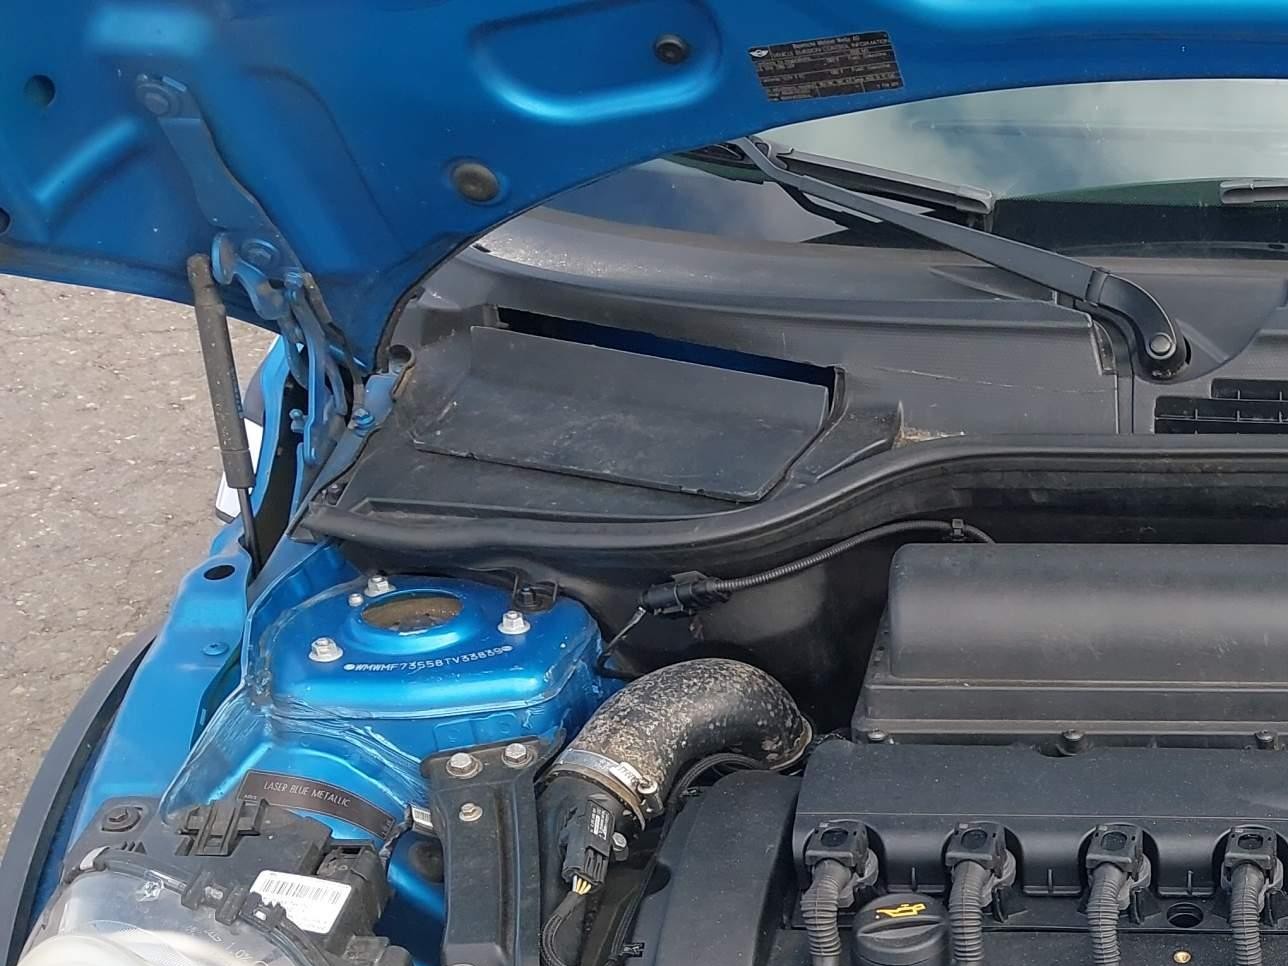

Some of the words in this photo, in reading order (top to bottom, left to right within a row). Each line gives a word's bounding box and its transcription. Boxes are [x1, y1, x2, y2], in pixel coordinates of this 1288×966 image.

[263, 781, 288, 793] LASER
[289, 784, 310, 796] BLUE
[311, 789, 352, 808] METALLIC
